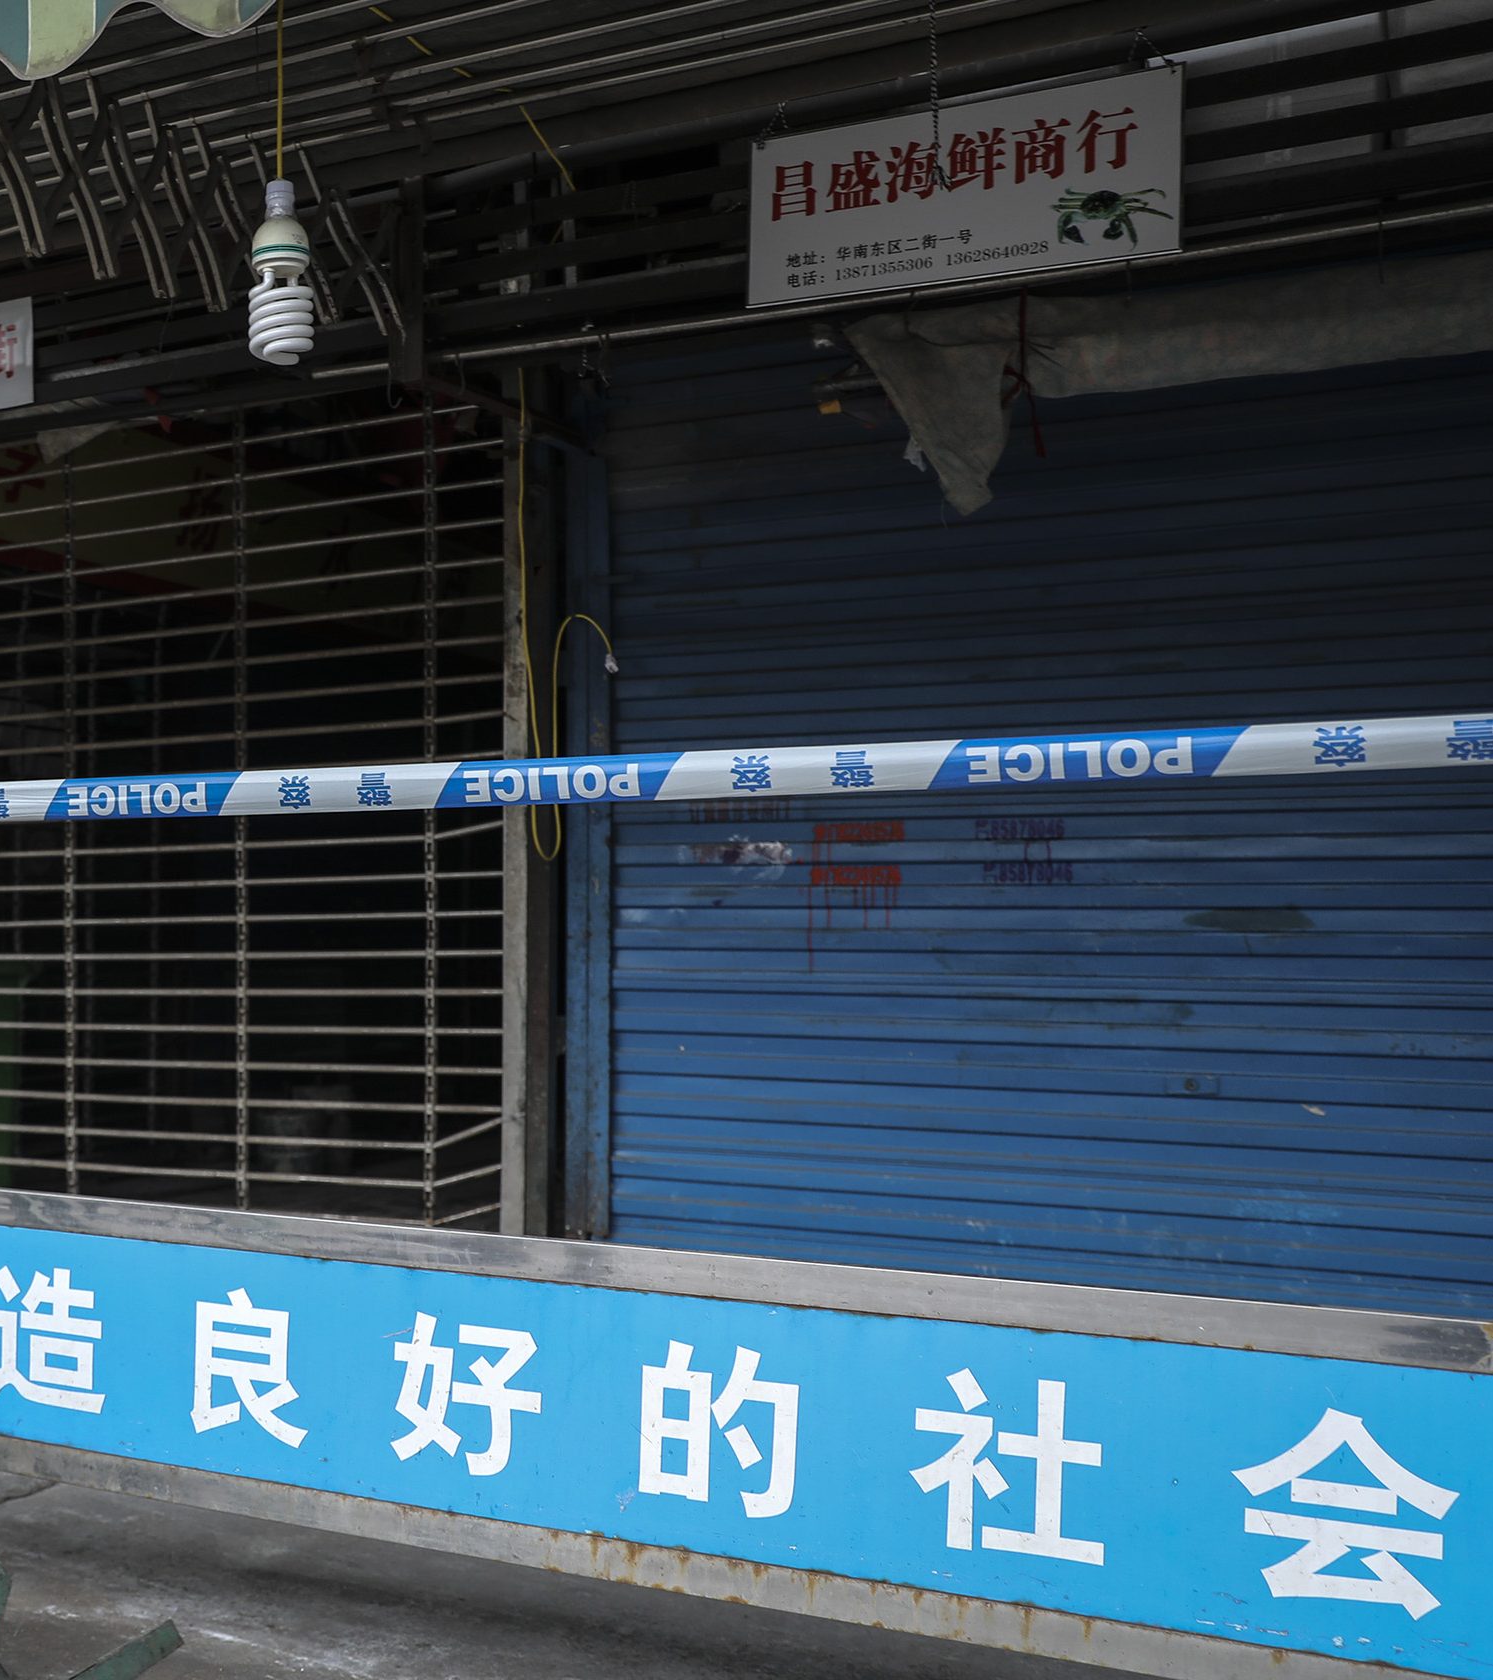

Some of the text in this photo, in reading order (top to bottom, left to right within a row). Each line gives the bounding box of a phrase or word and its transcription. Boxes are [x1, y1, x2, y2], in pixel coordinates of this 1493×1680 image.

[771, 106, 1138, 222] 昌盛海鲜商行
[835, 229, 973, 262] 华南东区二街一号
[835, 256, 933, 282] 13871355306
[945, 240, 1049, 267] 13628640928
[965, 736, 1194, 784] POLICE
[1314, 718, 1493, 768] 警察
[278, 772, 393, 811] 警察
[463, 763, 641, 803] POLICE
[730, 750, 876, 792] 警察
[67, 781, 207, 818] POLICE
